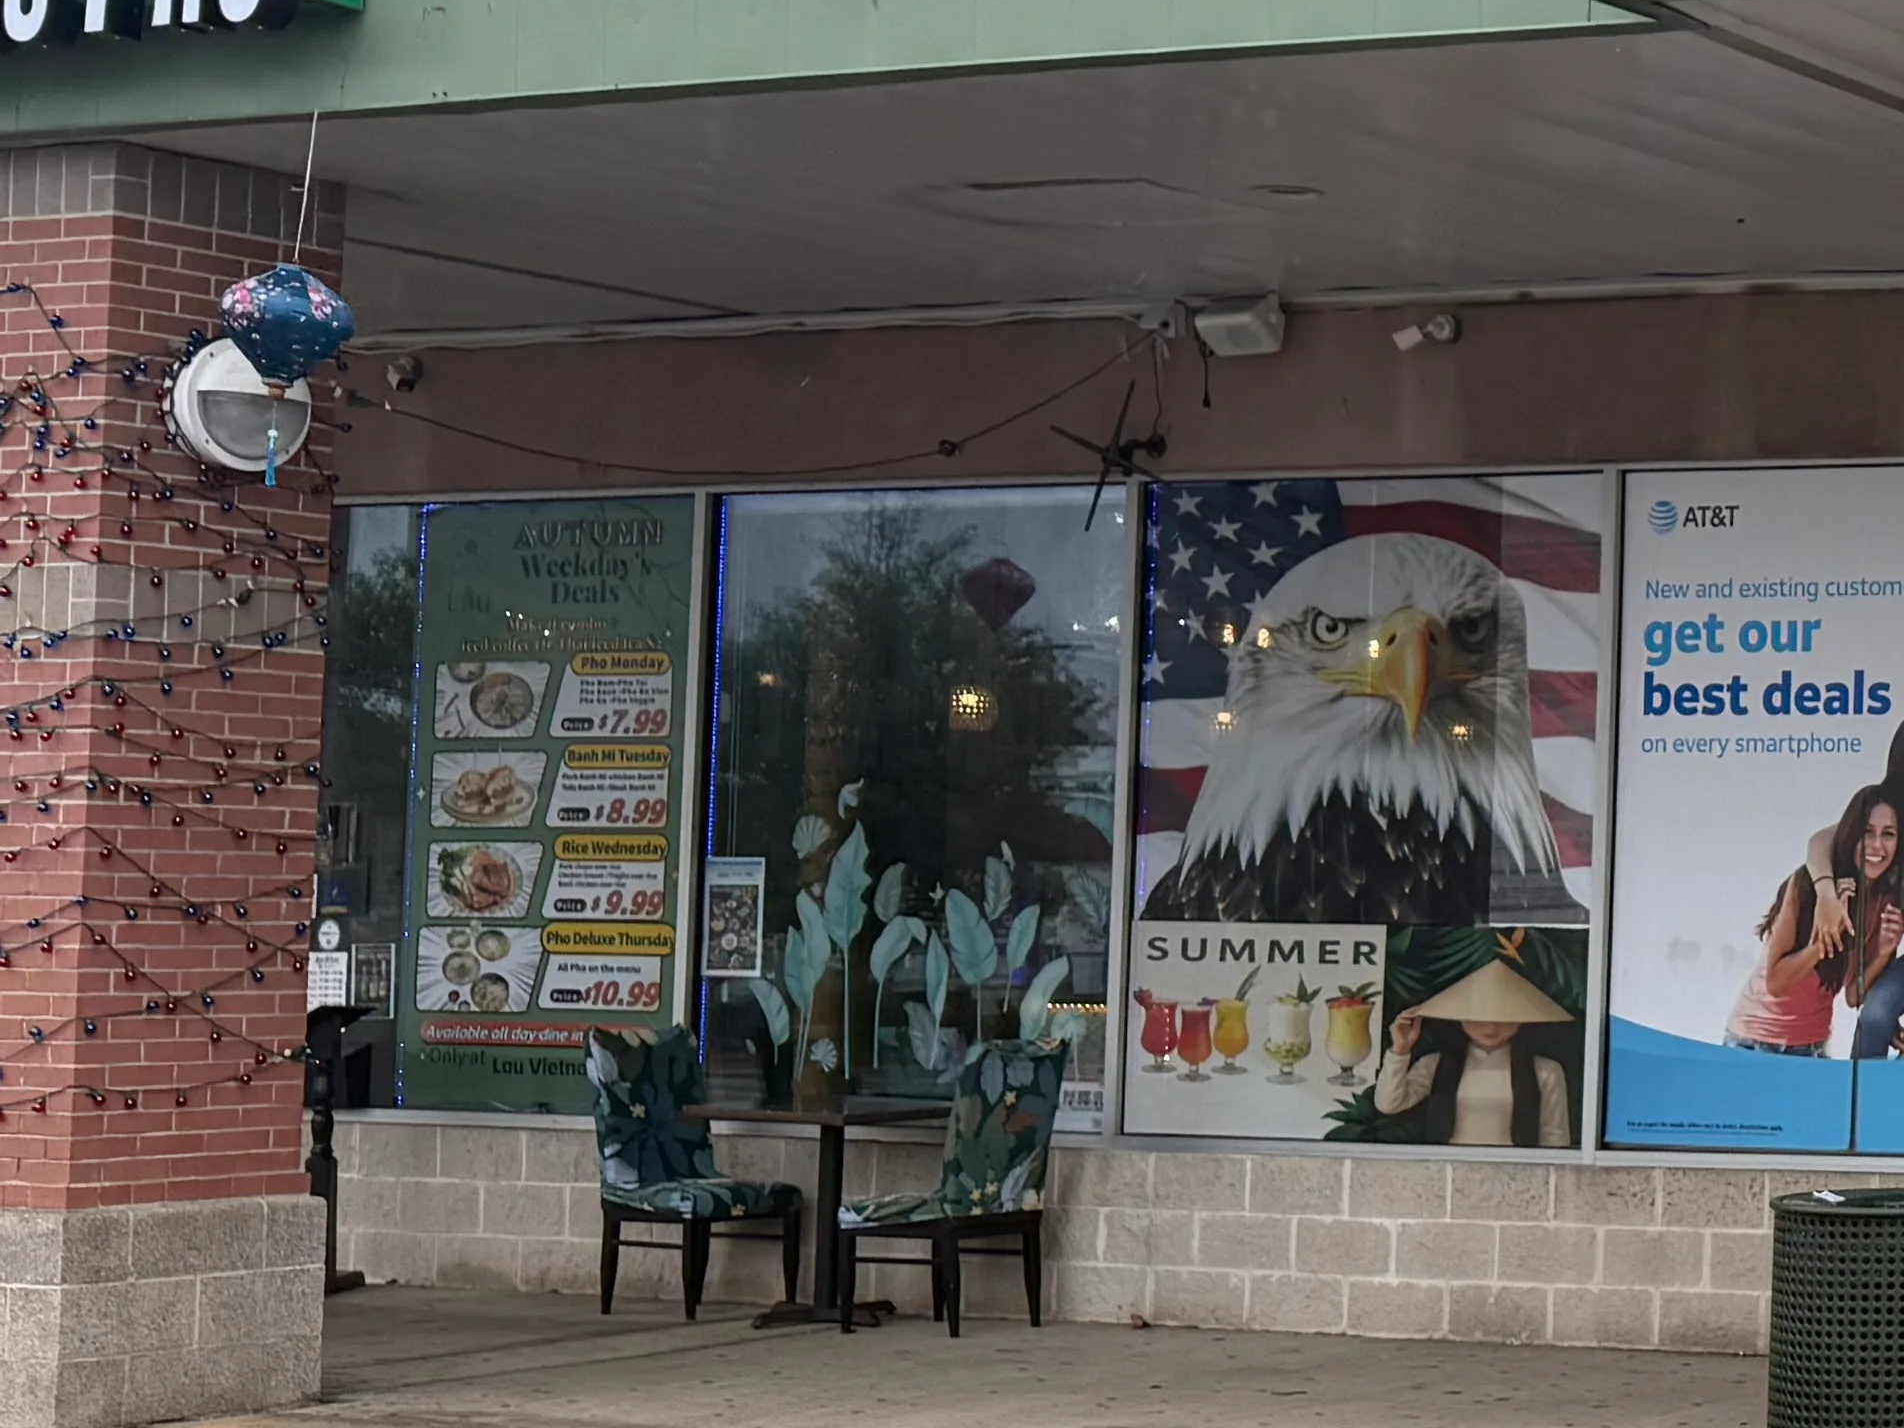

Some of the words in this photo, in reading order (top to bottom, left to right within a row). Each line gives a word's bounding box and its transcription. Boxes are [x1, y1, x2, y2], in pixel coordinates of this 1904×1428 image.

[1682, 504, 1740, 528] AT&T
[513, 519, 663, 549] AUTUMN
[551, 578, 620, 604] Deals
[1645, 578, 1690, 600] New
[1695, 577, 1734, 599] and
[1738, 576, 1820, 603] existing
[1643, 613, 1725, 667] get
[1738, 618, 1823, 653] our
[581, 657, 609, 670] Pho
[612, 655, 665, 672] Monday
[1643, 670, 1750, 716] best
[1762, 669, 1893, 716] deals
[567, 749, 599, 763] Banh
[619, 748, 670, 766] Tuesday
[1641, 737, 1667, 753] on
[1672, 737, 1730, 759] every
[1734, 732, 1863, 758] smartphone
[562, 840, 589, 855] Rice
[592, 841, 668, 860] Wednesday
[546, 933, 573, 946] Pho
[575, 934, 616, 947] Deluxe
[618, 935, 675, 950] Thursday
[1146, 935, 1378, 967] SUMMER
[427, 1025, 488, 1040] Available
[430, 1047, 467, 1067] Only
[469, 1049, 486, 1066] at
